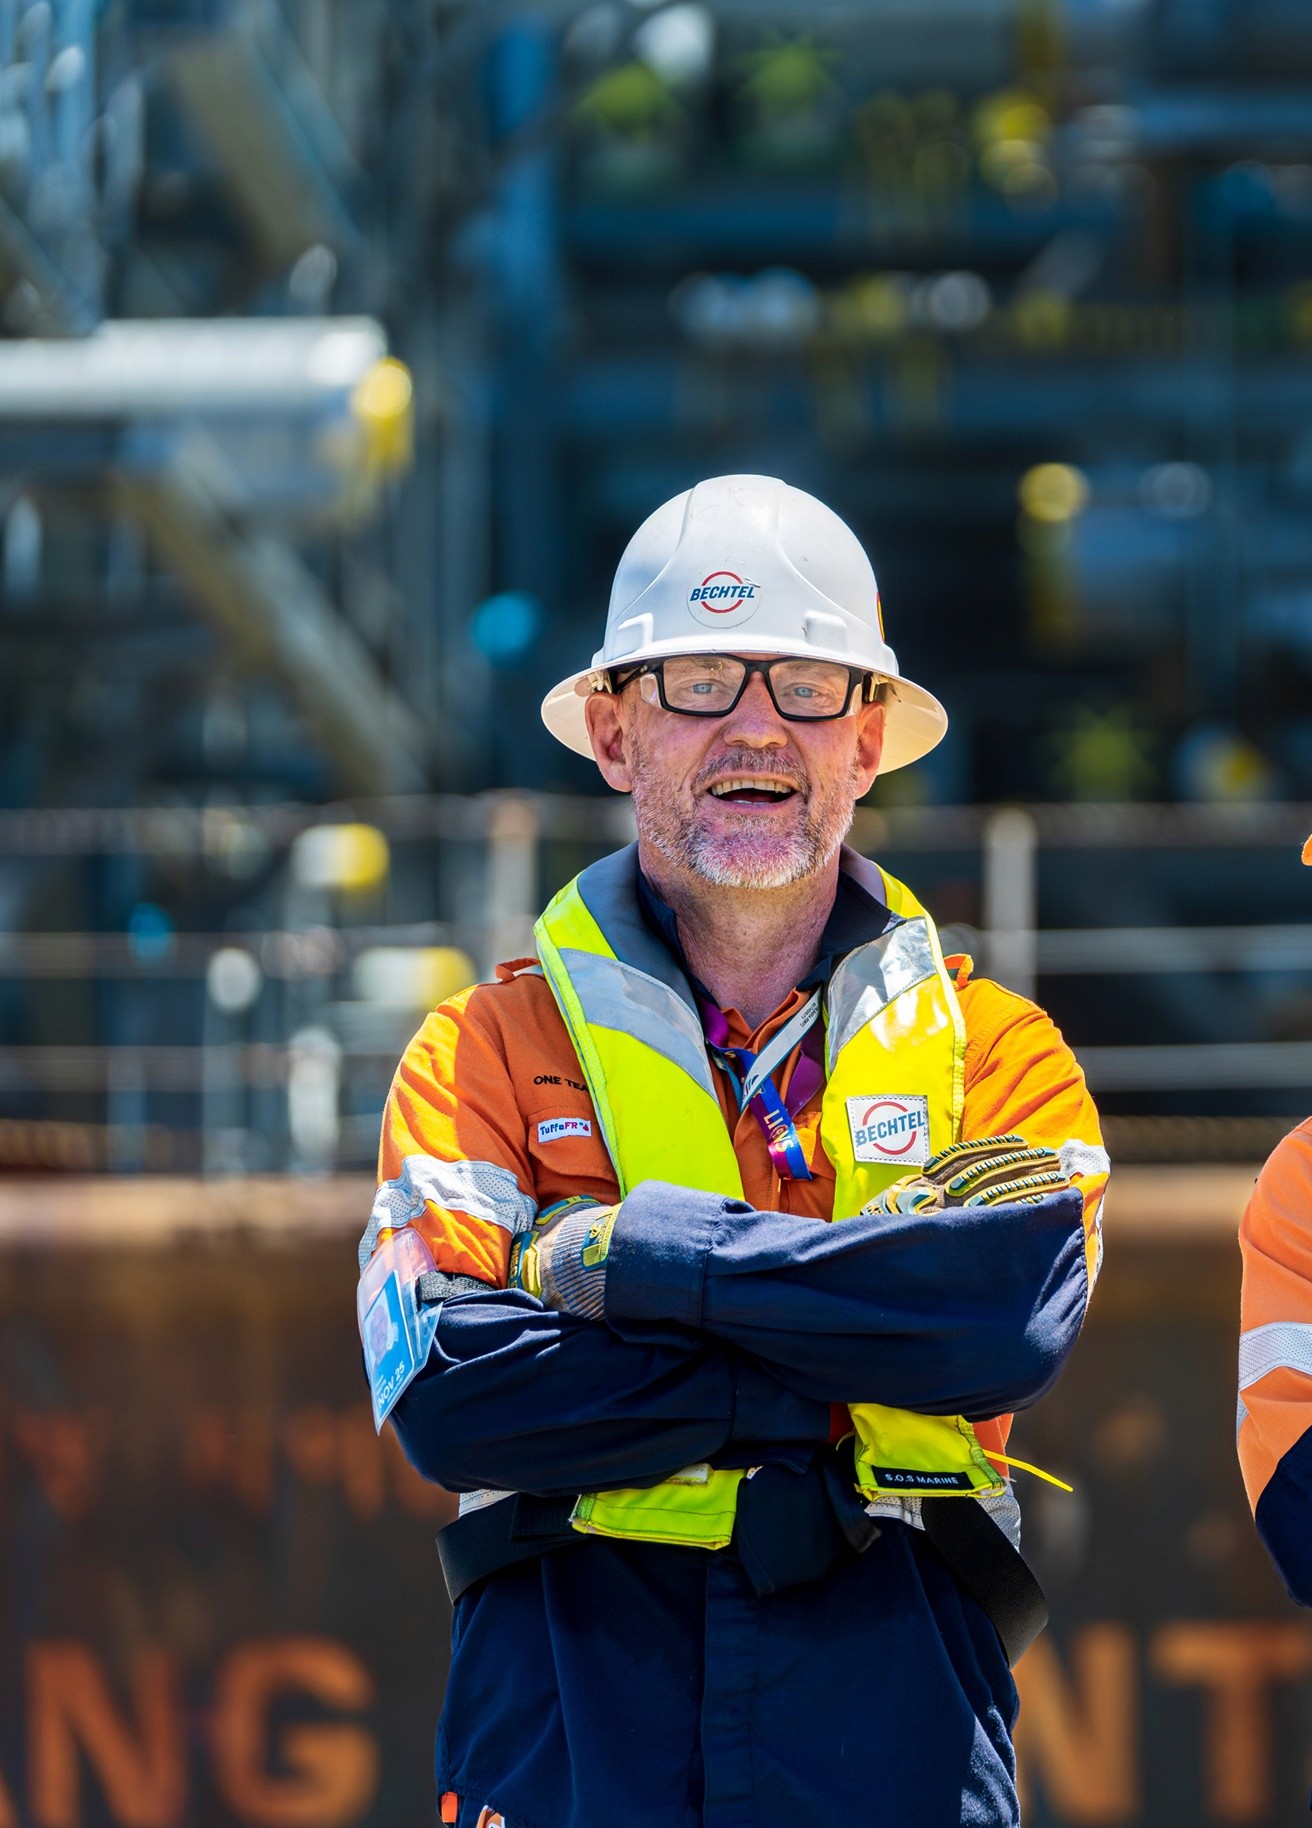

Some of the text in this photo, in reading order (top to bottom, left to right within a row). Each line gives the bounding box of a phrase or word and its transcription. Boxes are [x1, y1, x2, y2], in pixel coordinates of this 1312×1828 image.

[689, 585, 755, 602] BECHTEL
[533, 1074, 590, 1094] ONE TEA
[763, 1109, 795, 1153] LIONS
[855, 1110, 926, 1147] BECHTEL
[885, 1473, 959, 1484] S.O.S MARINE
